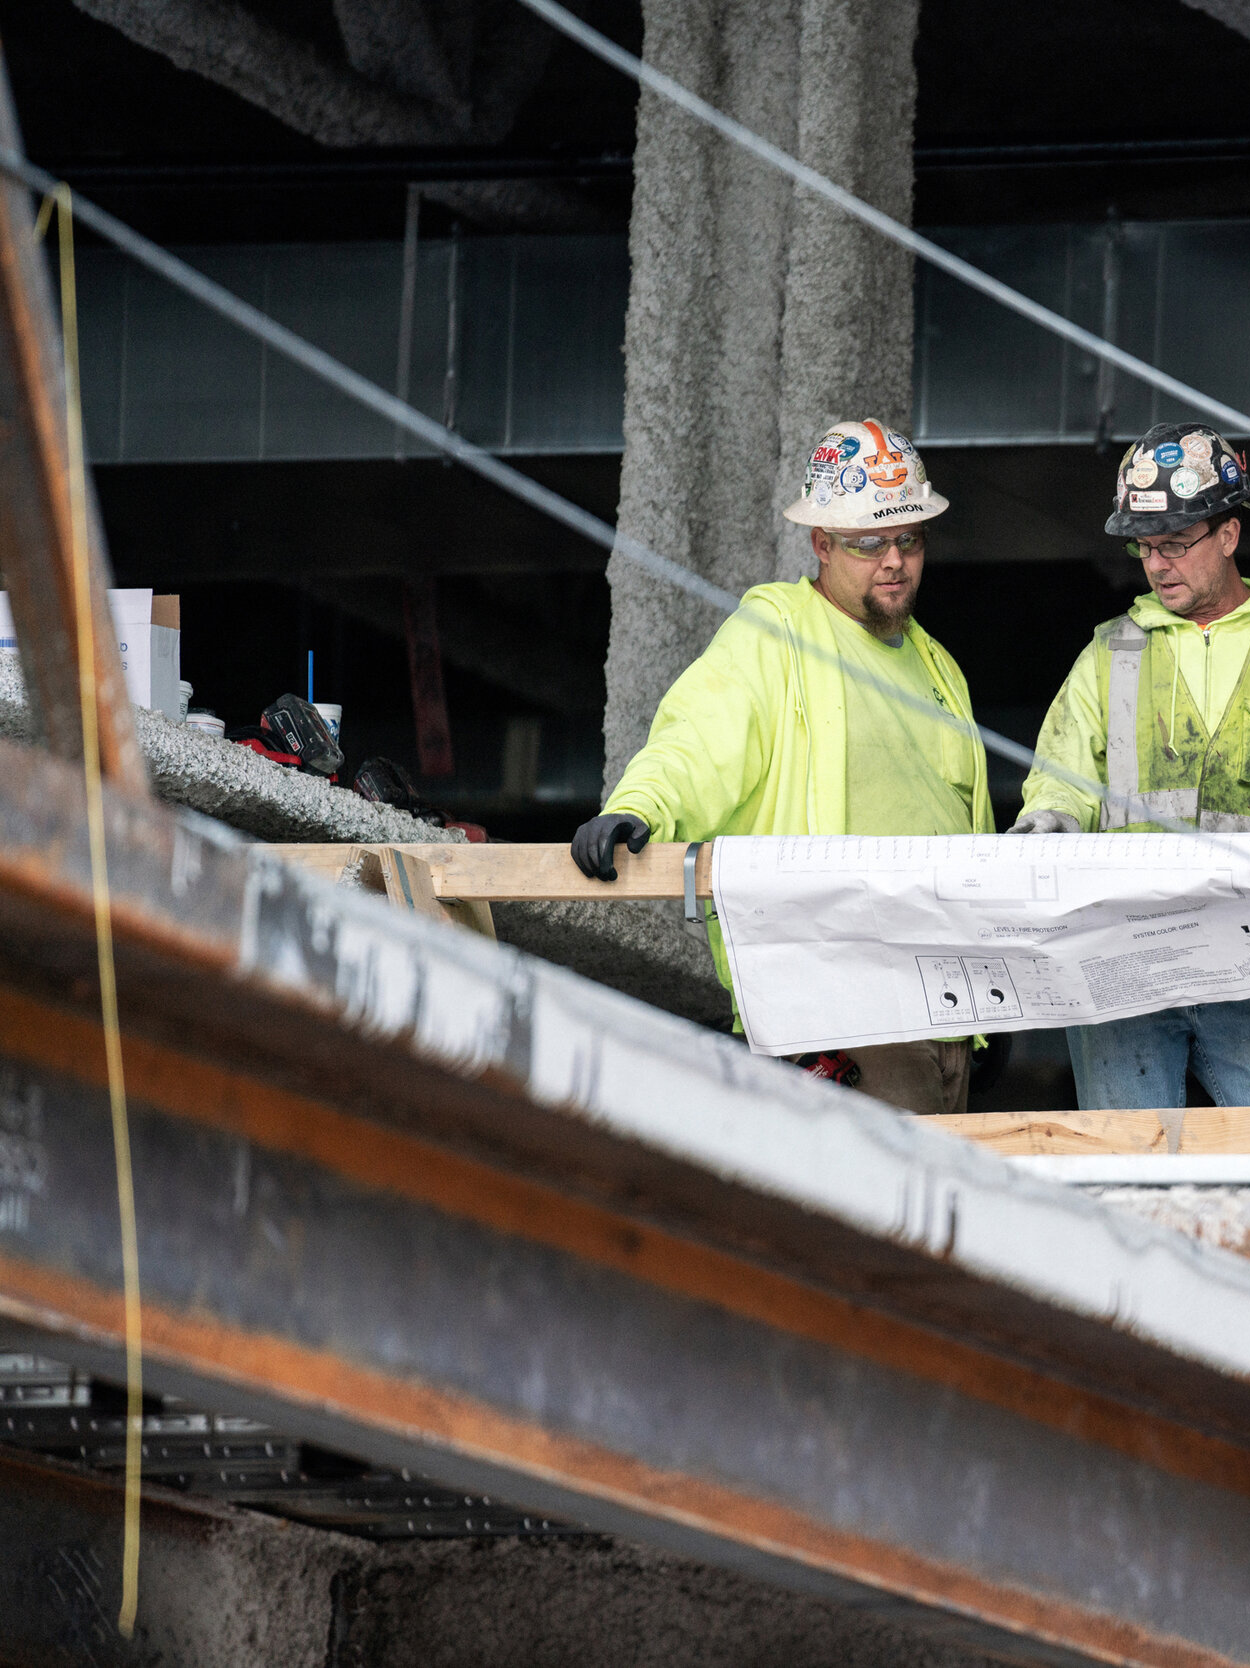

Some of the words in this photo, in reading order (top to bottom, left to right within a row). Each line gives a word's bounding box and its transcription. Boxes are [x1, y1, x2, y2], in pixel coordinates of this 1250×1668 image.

[1032, 924, 1069, 934] PROTECTION
[1132, 930, 1156, 939] SYSTEM
[1178, 921, 1200, 931] GREEN
